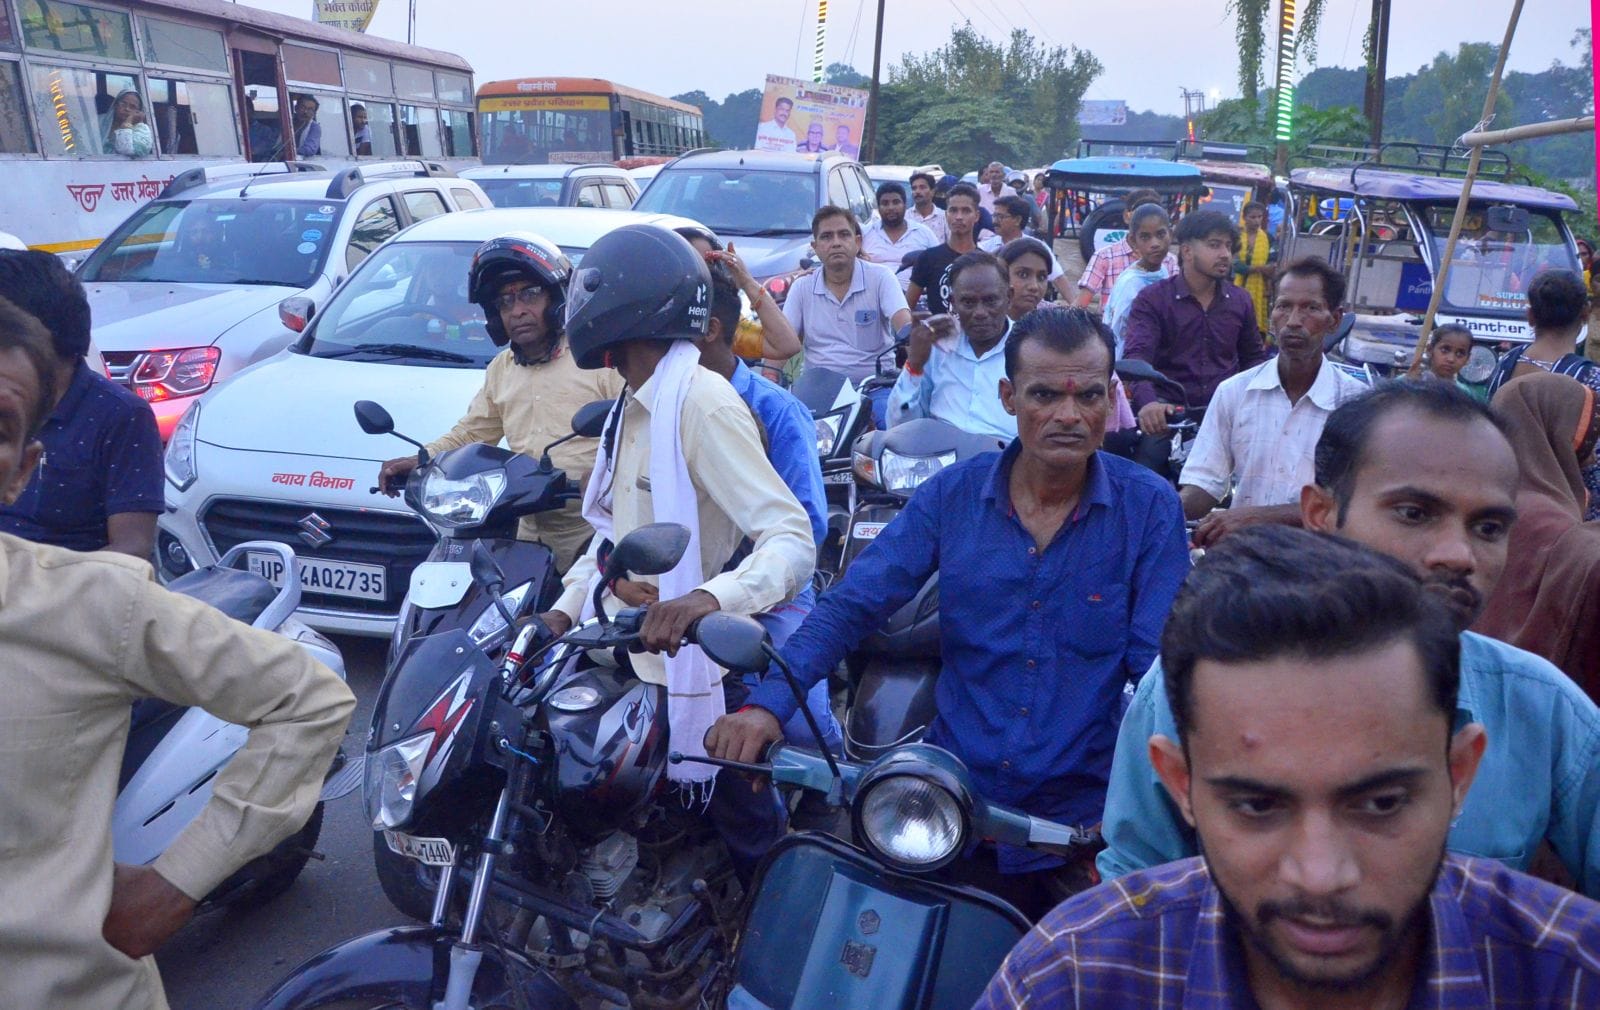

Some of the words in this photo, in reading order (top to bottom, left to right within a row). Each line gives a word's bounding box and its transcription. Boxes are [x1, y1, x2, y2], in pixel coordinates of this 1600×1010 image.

[111, 182, 137, 203] उत्तर
[136, 174, 161, 200] प्रदेश
[1496, 291, 1525, 300] SUPER
[688, 306, 707, 317] Hero
[272, 472, 307, 487] न्याय
[308, 470, 356, 491] विभाग
[421, 843, 452, 863] 7440
